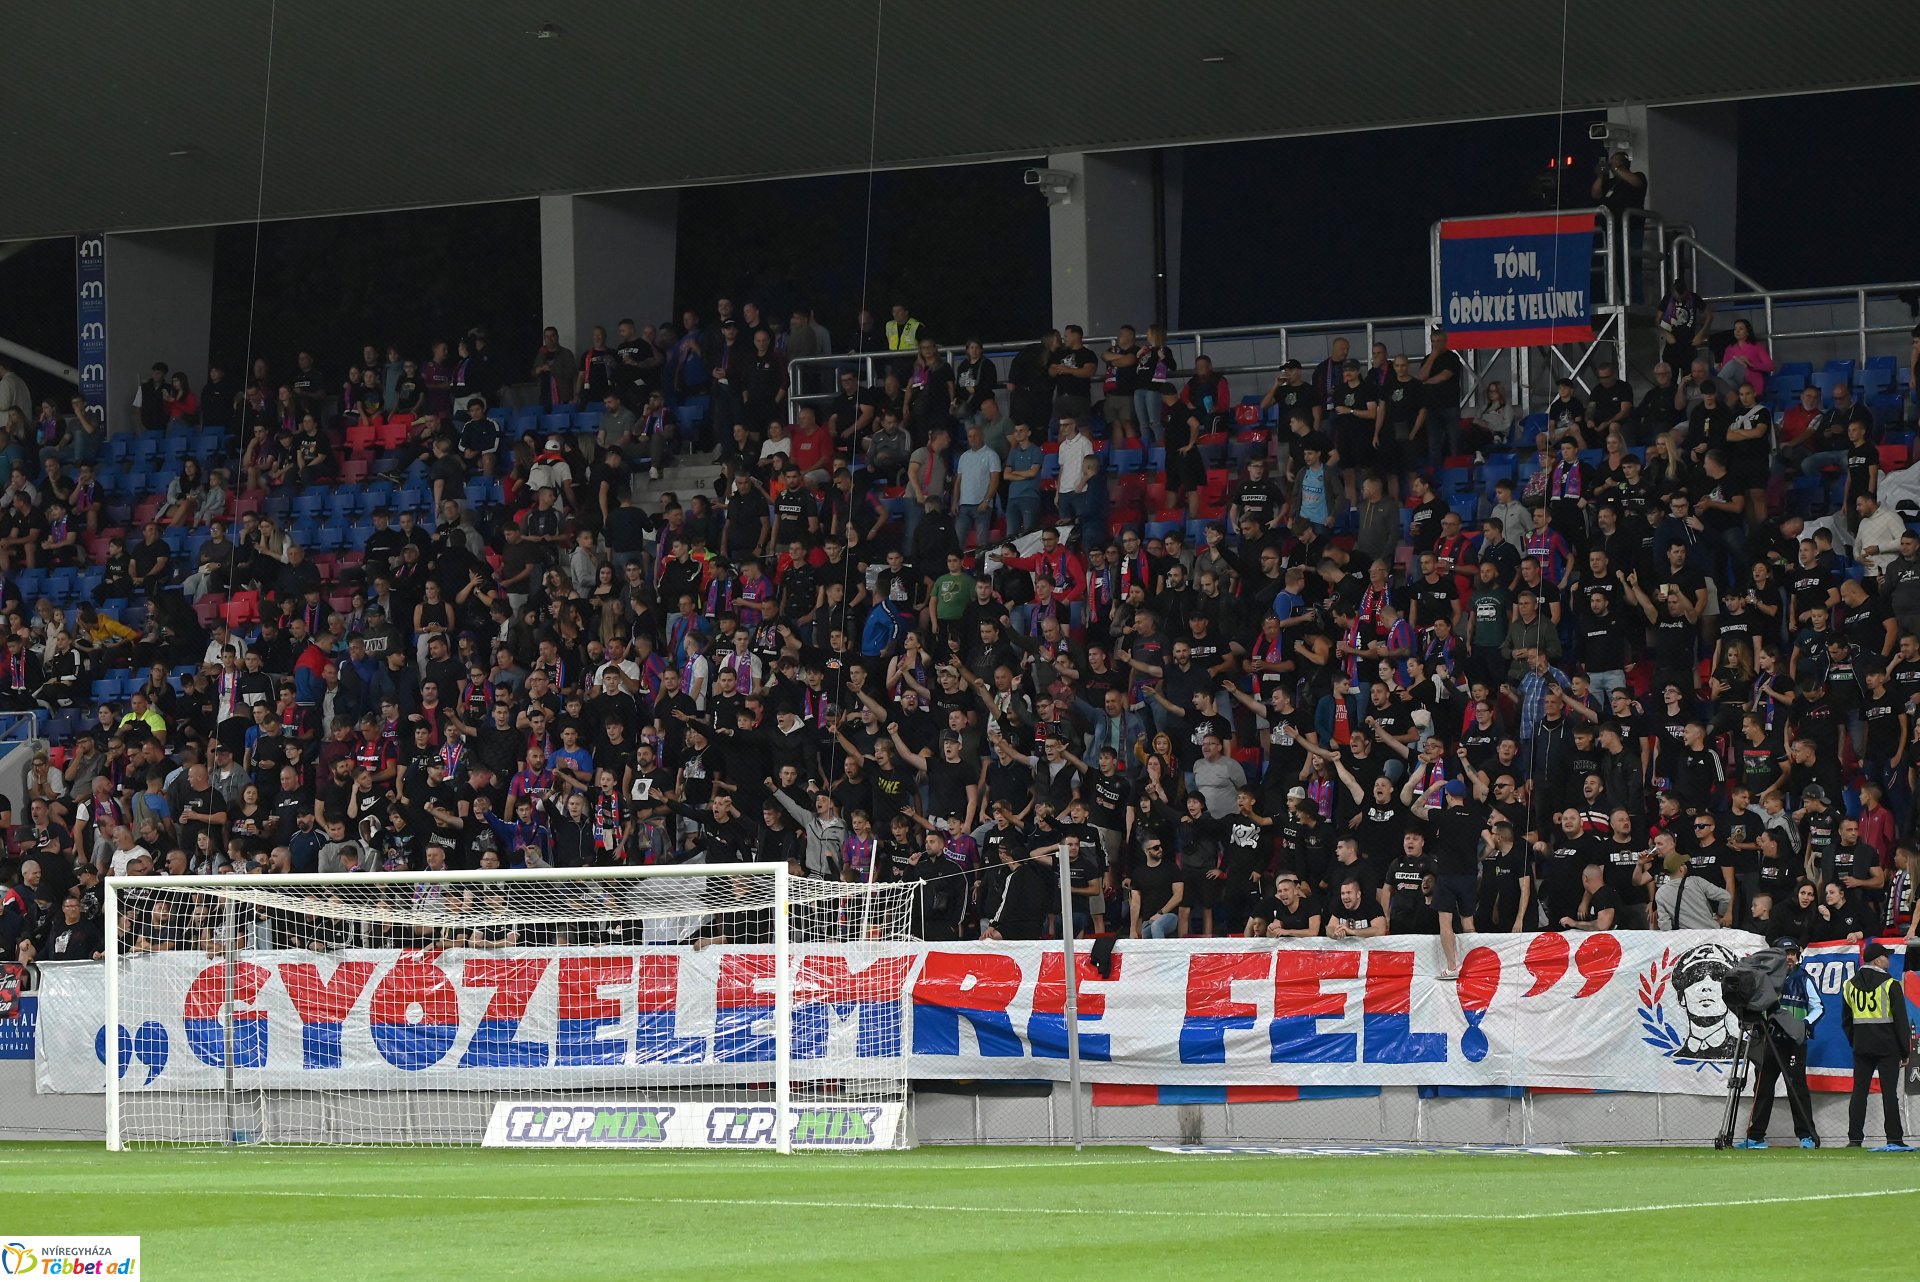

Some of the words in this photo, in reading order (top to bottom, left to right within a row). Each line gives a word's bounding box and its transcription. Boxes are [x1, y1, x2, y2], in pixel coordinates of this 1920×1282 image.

[1493, 245, 1541, 281] TÓNI,
[1449, 287, 1515, 325] ÖRÖKKÉ
[1518, 286, 1585, 321] VELÜNK!
